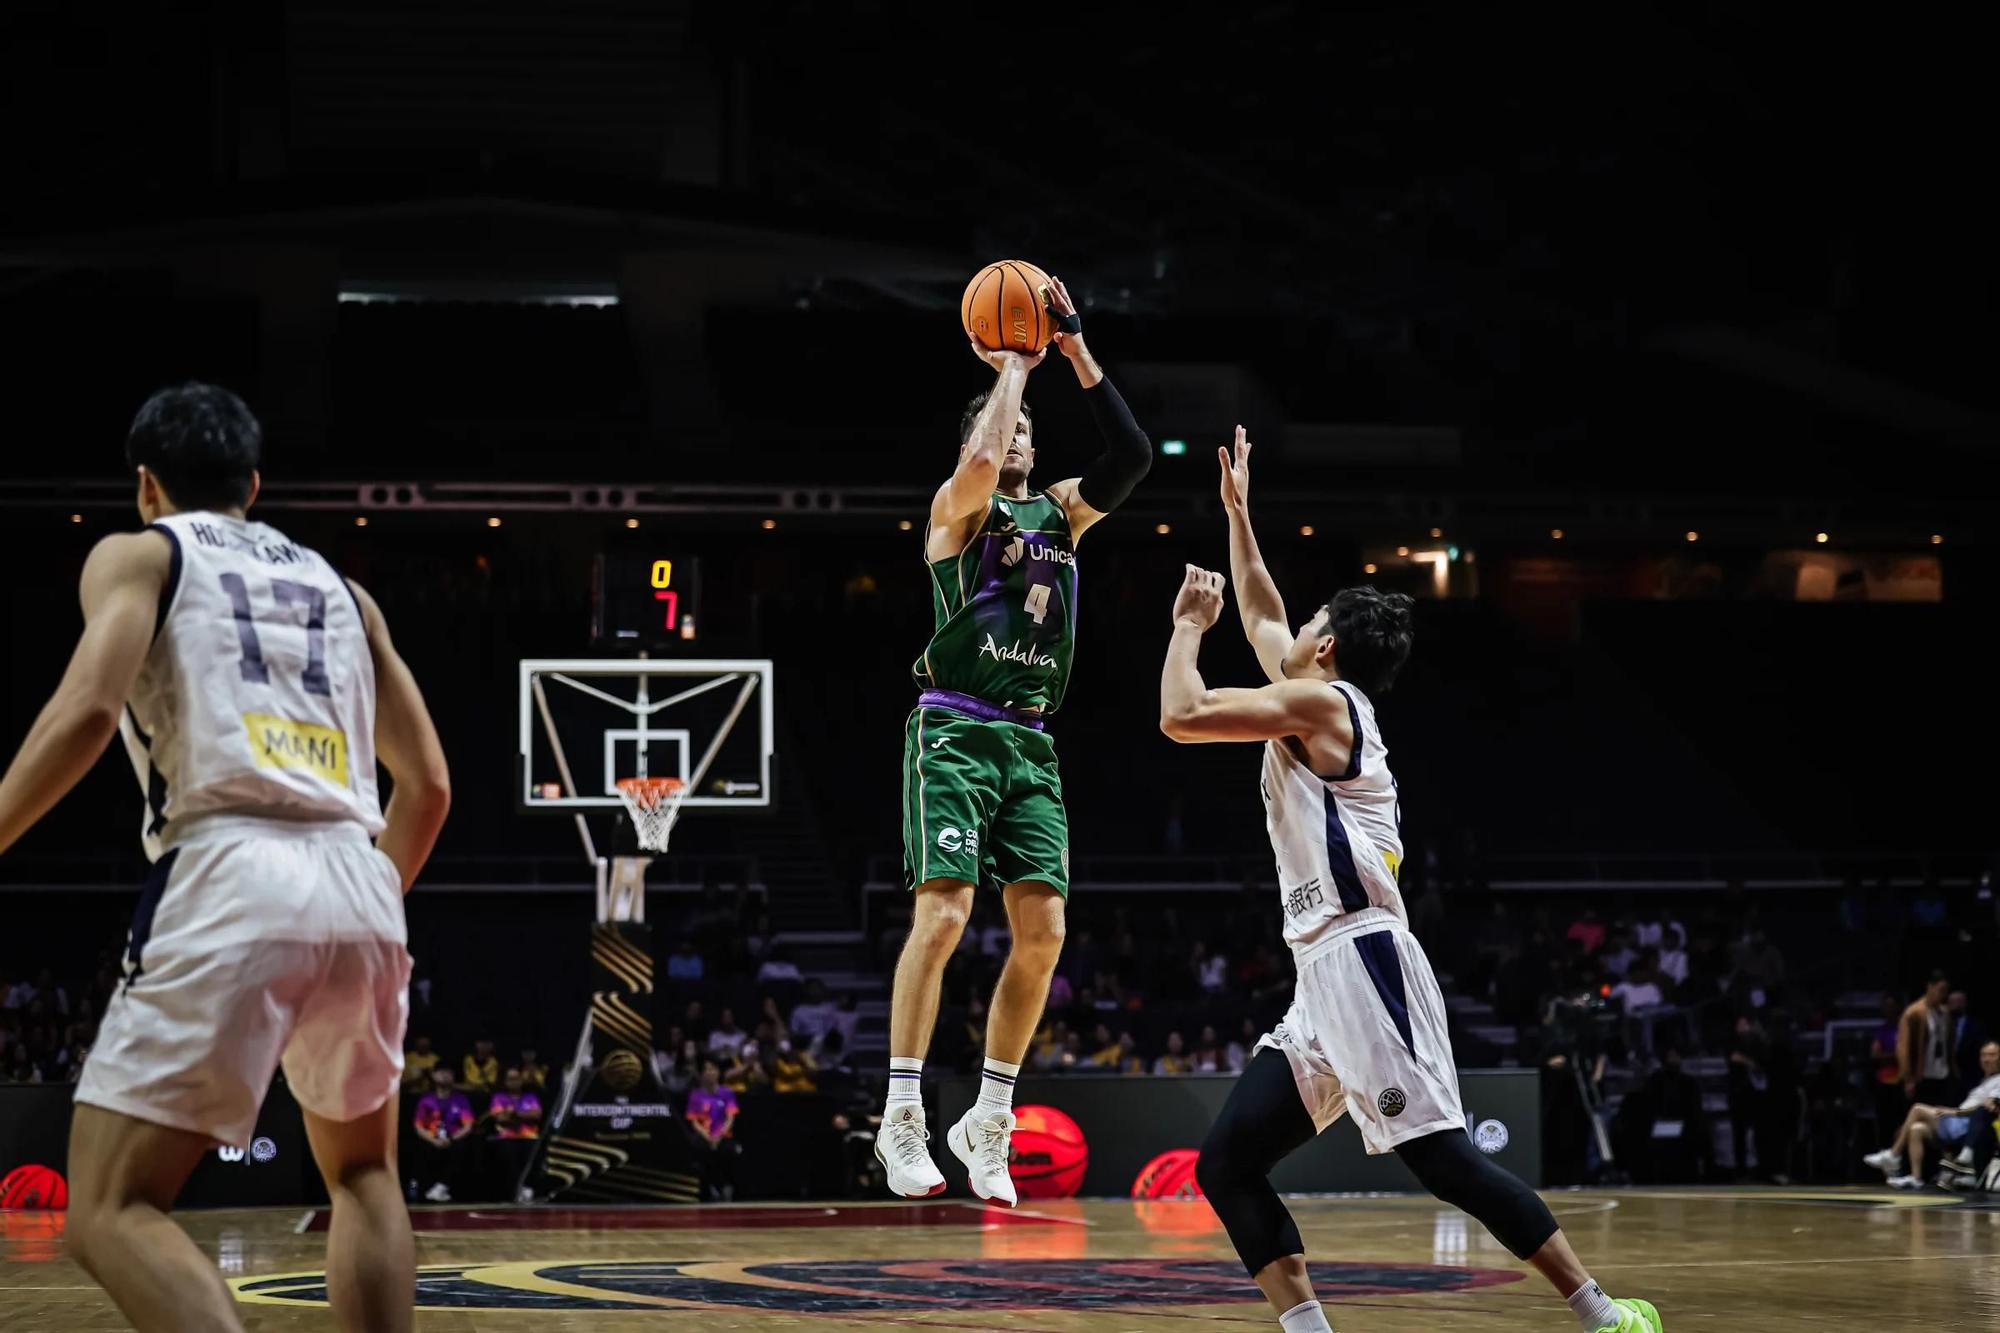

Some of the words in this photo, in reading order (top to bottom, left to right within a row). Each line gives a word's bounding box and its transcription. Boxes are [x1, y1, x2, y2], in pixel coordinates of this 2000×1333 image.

[651, 560, 671, 588] 0
[1030, 544, 1075, 569] Unica
[655, 590, 677, 630] 7
[1024, 583, 1051, 624] 4
[219, 572, 331, 697] 17
[264, 728, 336, 770] MANI
